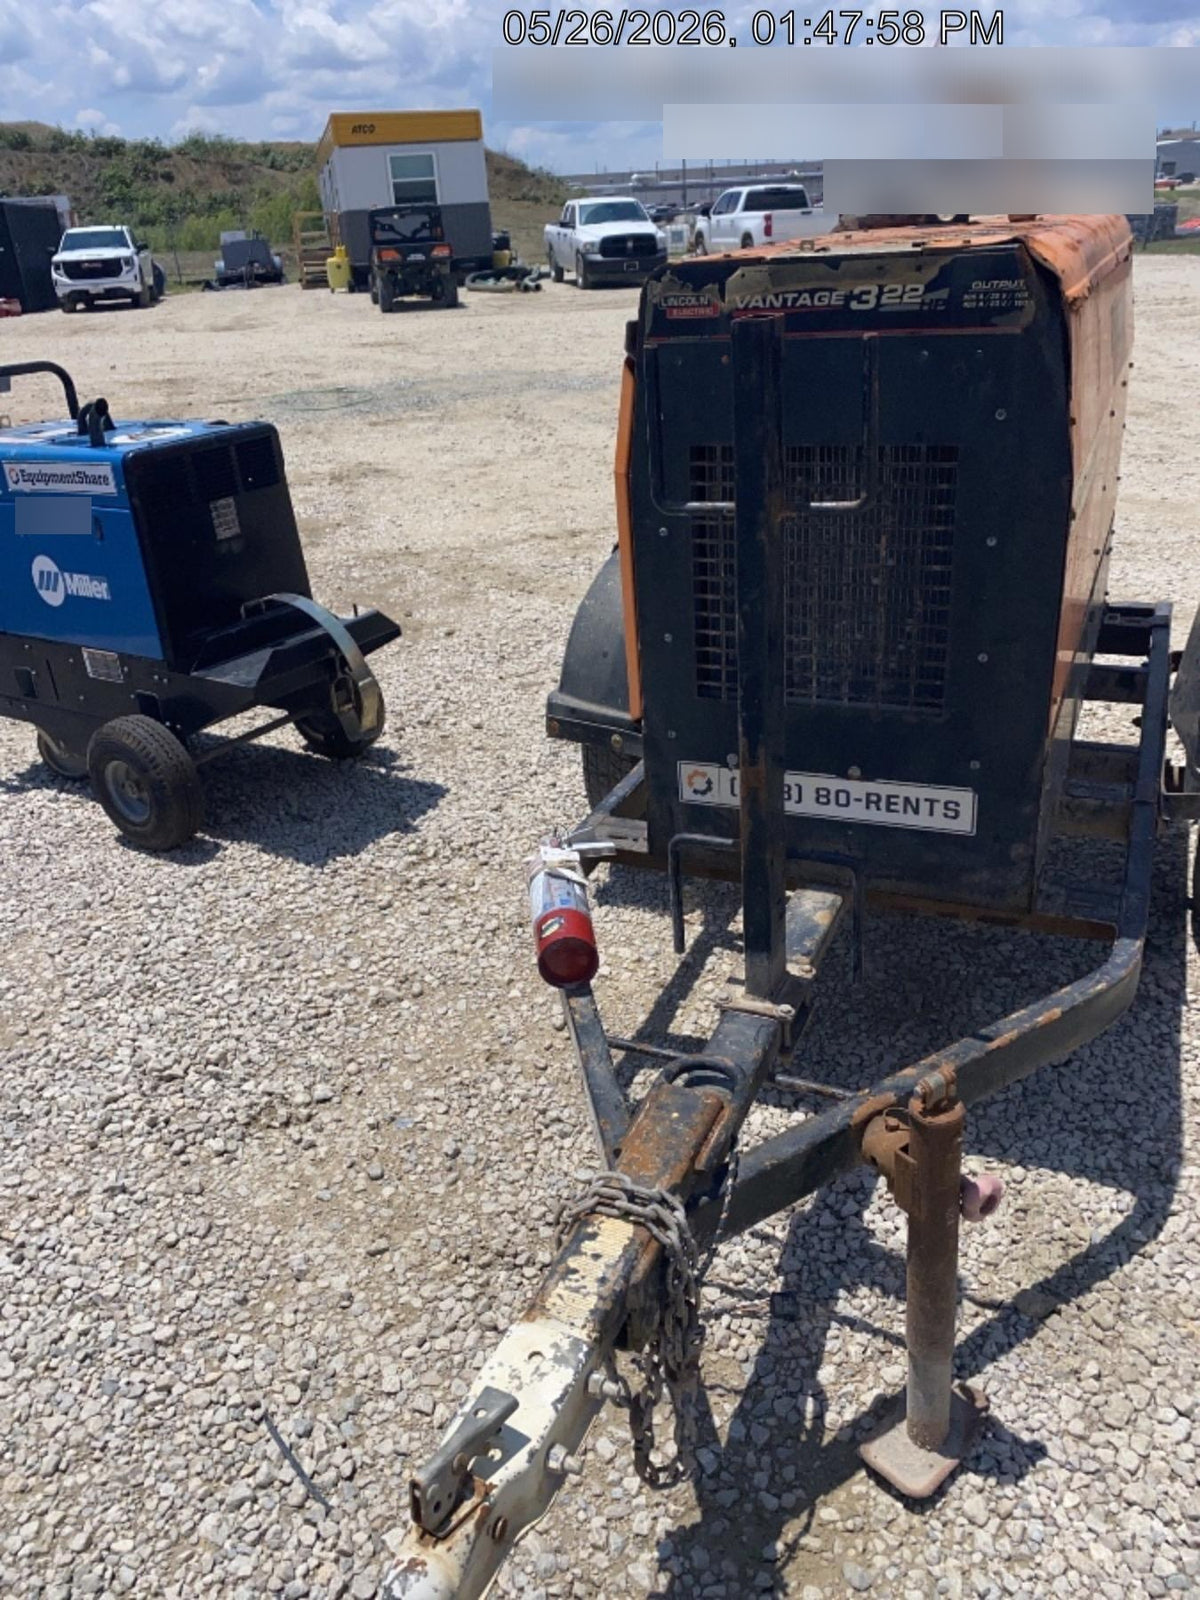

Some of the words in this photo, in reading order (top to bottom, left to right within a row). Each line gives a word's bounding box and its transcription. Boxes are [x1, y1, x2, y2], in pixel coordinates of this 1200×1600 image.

[351, 123, 376, 134] ATCO
[972, 279, 1026, 290] OUTPUT
[661, 294, 709, 307] LINCOLN
[735, 290, 846, 309] VANTAGE
[850, 283, 926, 311] 322
[671, 307, 714, 317] ELECTRIC
[20, 469, 110, 487] EquipmentShare
[64, 572, 109, 599] Miller
[814, 786, 961, 821] 80-RENTS
